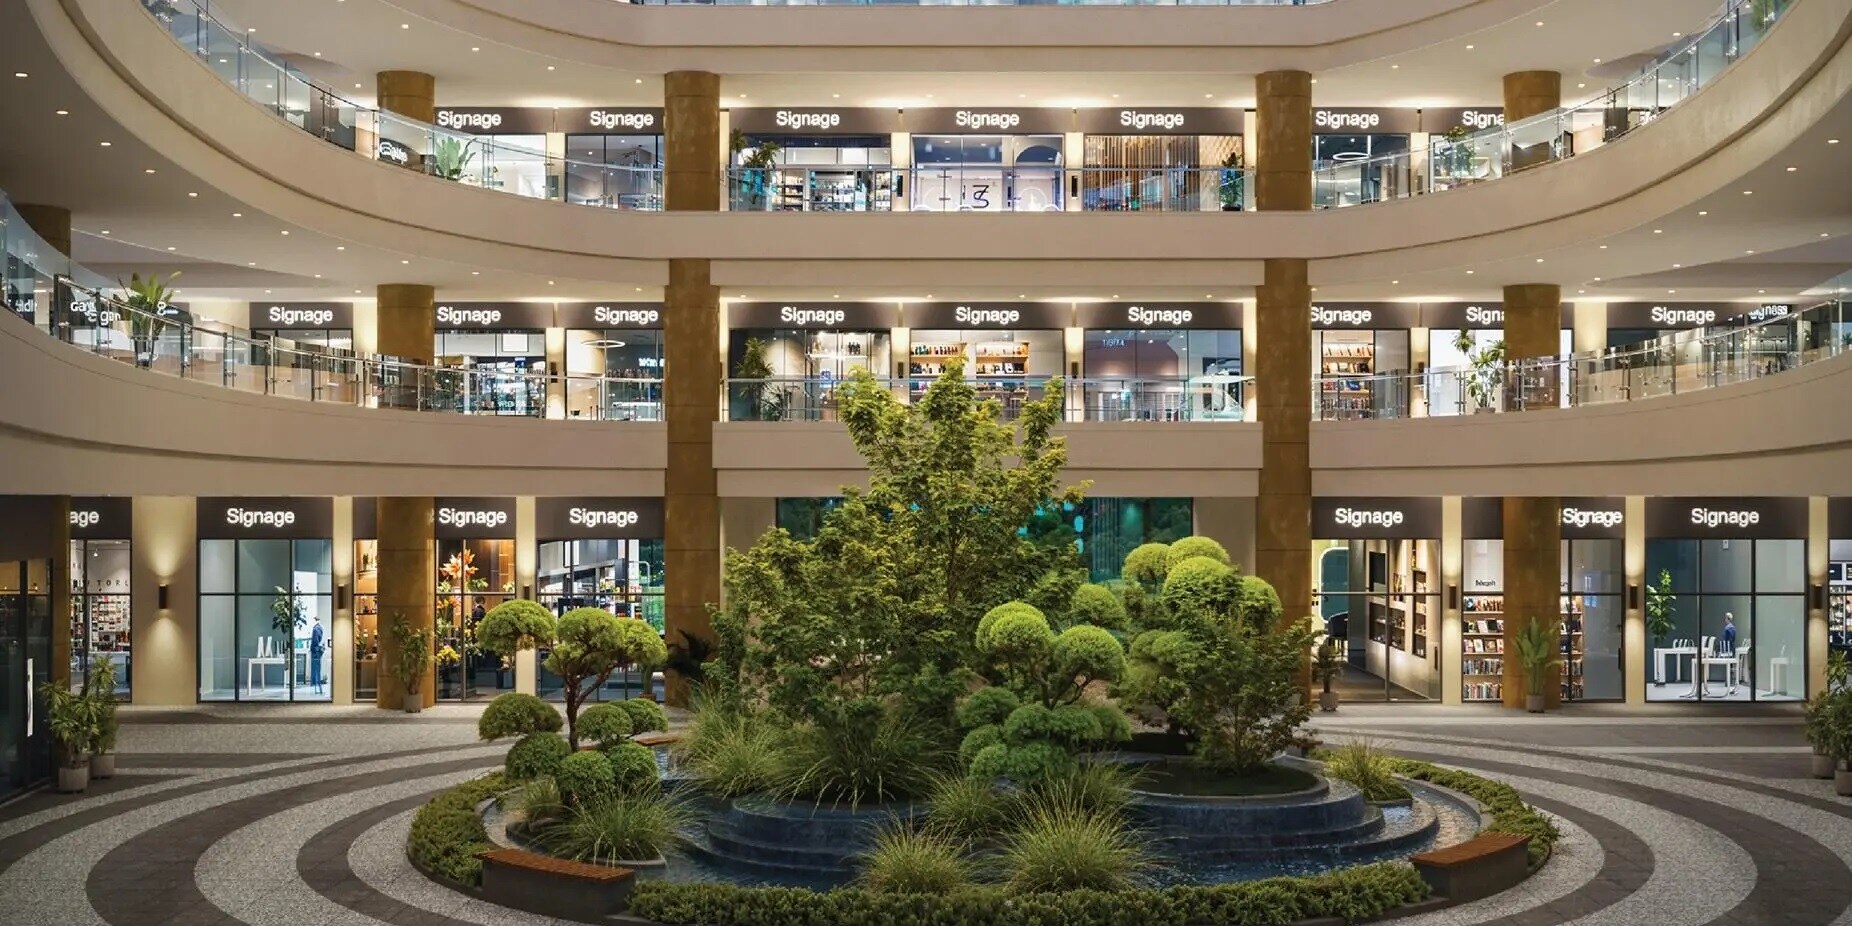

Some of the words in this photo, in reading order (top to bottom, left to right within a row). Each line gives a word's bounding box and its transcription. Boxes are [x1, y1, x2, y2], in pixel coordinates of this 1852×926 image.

[438, 111, 501, 129] Signage
[590, 111, 653, 129] Signage
[776, 111, 840, 129] Signage
[956, 111, 1019, 129] Signage
[1121, 111, 1184, 129] Signage
[1316, 111, 1379, 129] Signage
[270, 307, 333, 325] Signage
[437, 307, 501, 325] Signage
[595, 307, 658, 325] Signage
[781, 307, 844, 325] Signage
[956, 307, 1019, 325] Signage
[1128, 307, 1192, 325] Signage
[1311, 307, 1371, 325] Signage
[1652, 307, 1715, 324] Signage
[227, 508, 294, 527] Signage
[439, 508, 507, 527] Signage
[570, 508, 638, 527] Signage
[1335, 508, 1403, 527] Signage
[1563, 508, 1623, 527] Signage
[1692, 508, 1759, 527] Signage
